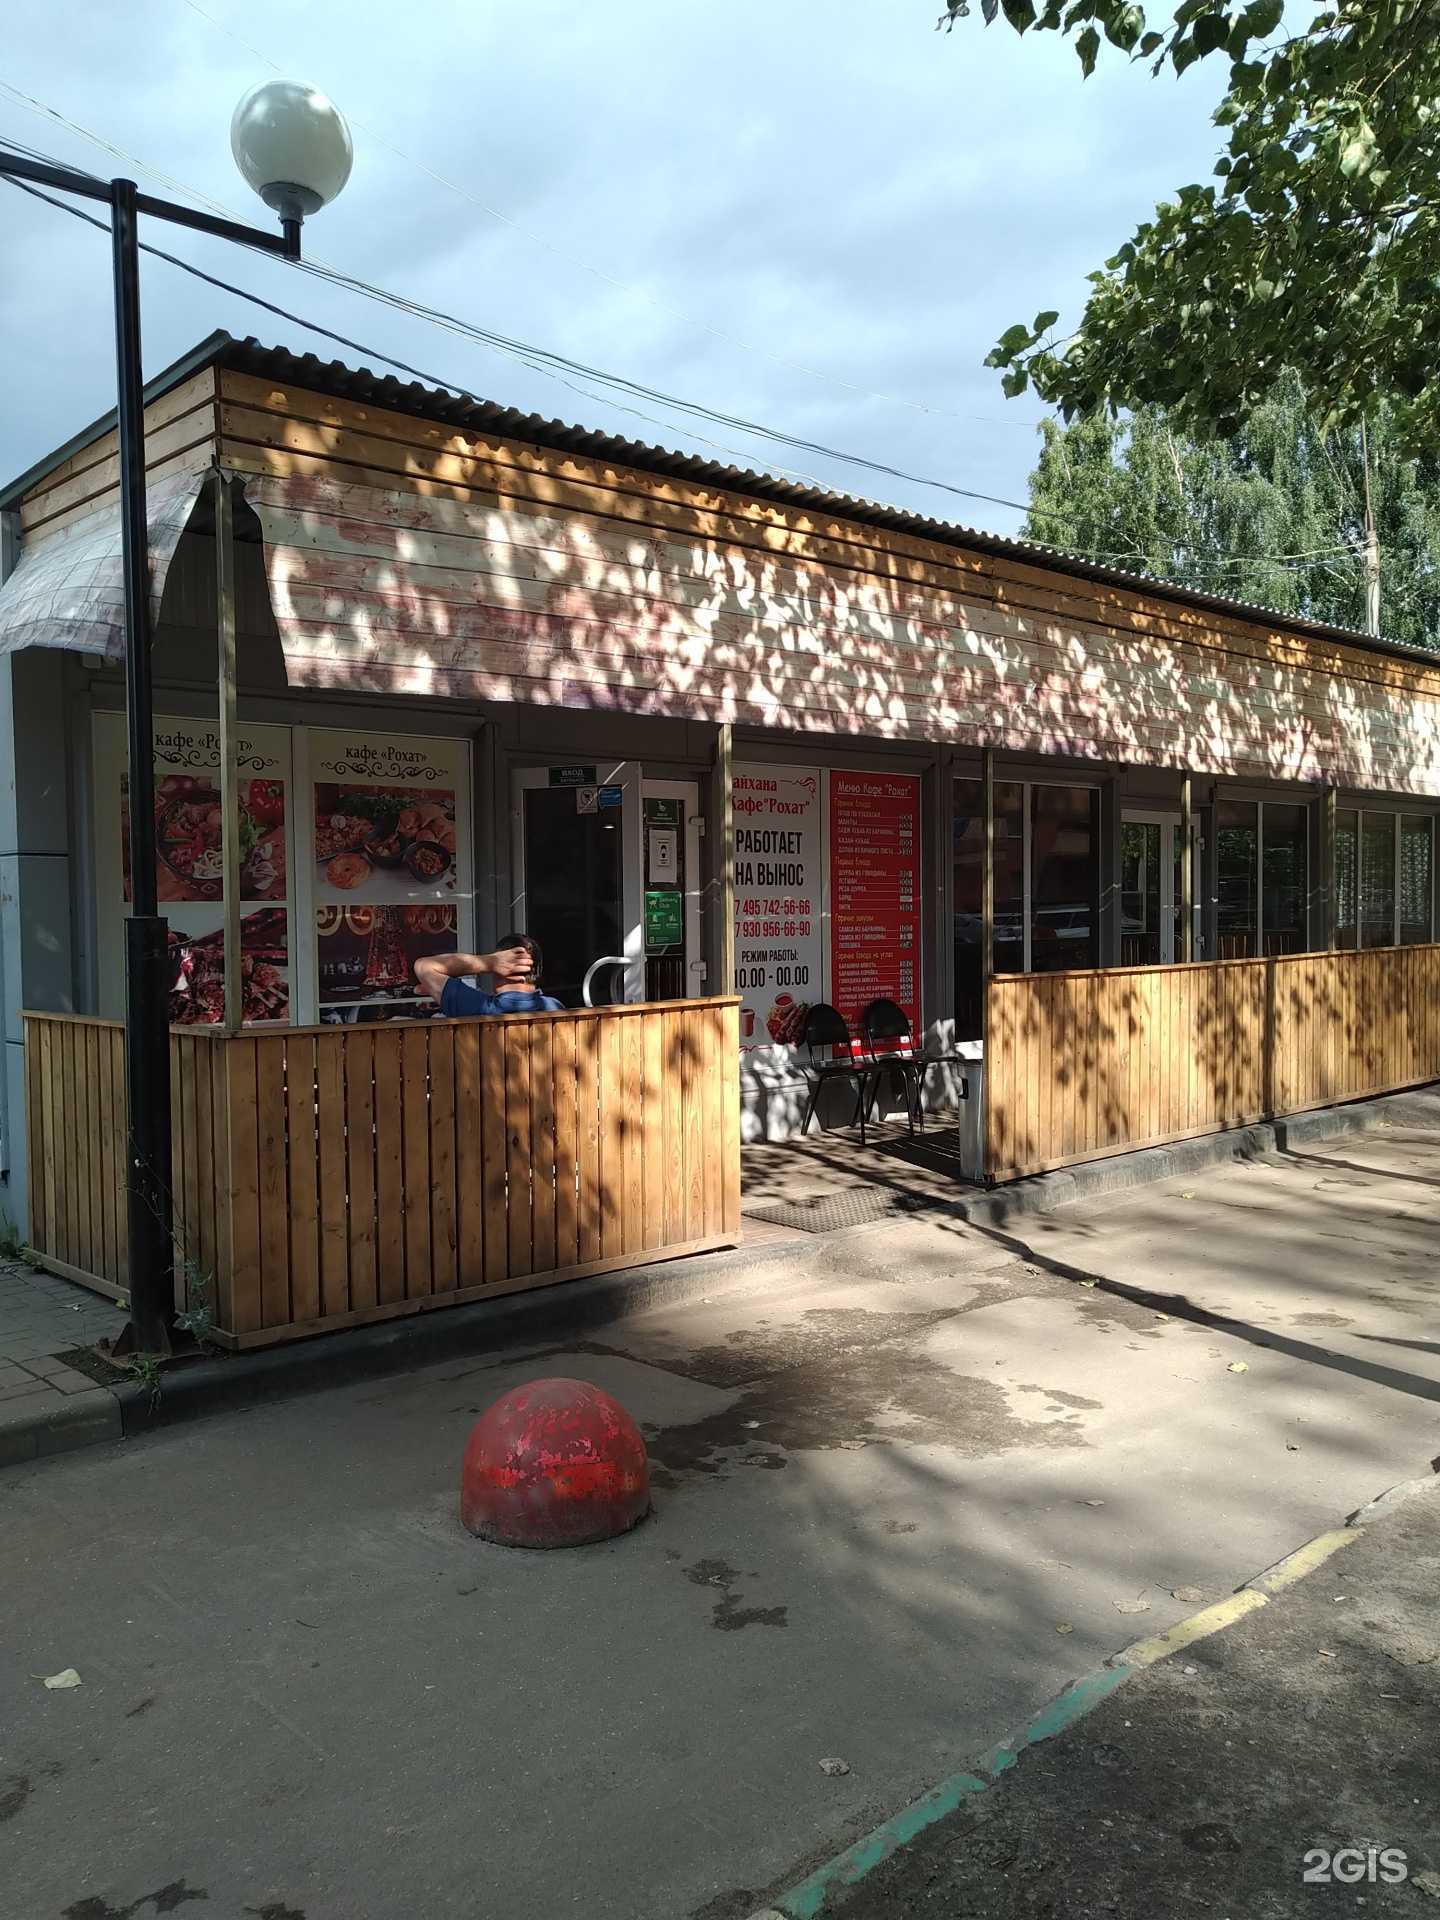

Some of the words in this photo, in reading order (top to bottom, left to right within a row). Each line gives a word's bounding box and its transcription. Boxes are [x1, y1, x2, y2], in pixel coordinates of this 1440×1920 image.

[155, 731, 193, 751] кафе
[197, 734, 254, 751] «Рот»
[345, 743, 378, 762] кафе
[380, 747, 427, 763] «Рохат»
[732, 774, 777, 792] айхана
[838, 780, 861, 793] Меню
[863, 783, 882, 797] Кафе
[735, 829, 803, 854] РАБОТАЕТ
[735, 862, 754, 886] НА
[757, 862, 804, 886] ВЫНОС
[742, 899, 761, 915] 495
[763, 899, 810, 915] 742-56-66
[743, 921, 761, 937] 930
[742, 950, 767, 963] РЕЖИМ
[769, 949, 799, 962] РАБОТЫ:
[734, 967, 766, 988] 10.00
[776, 966, 809, 986] 00.00
